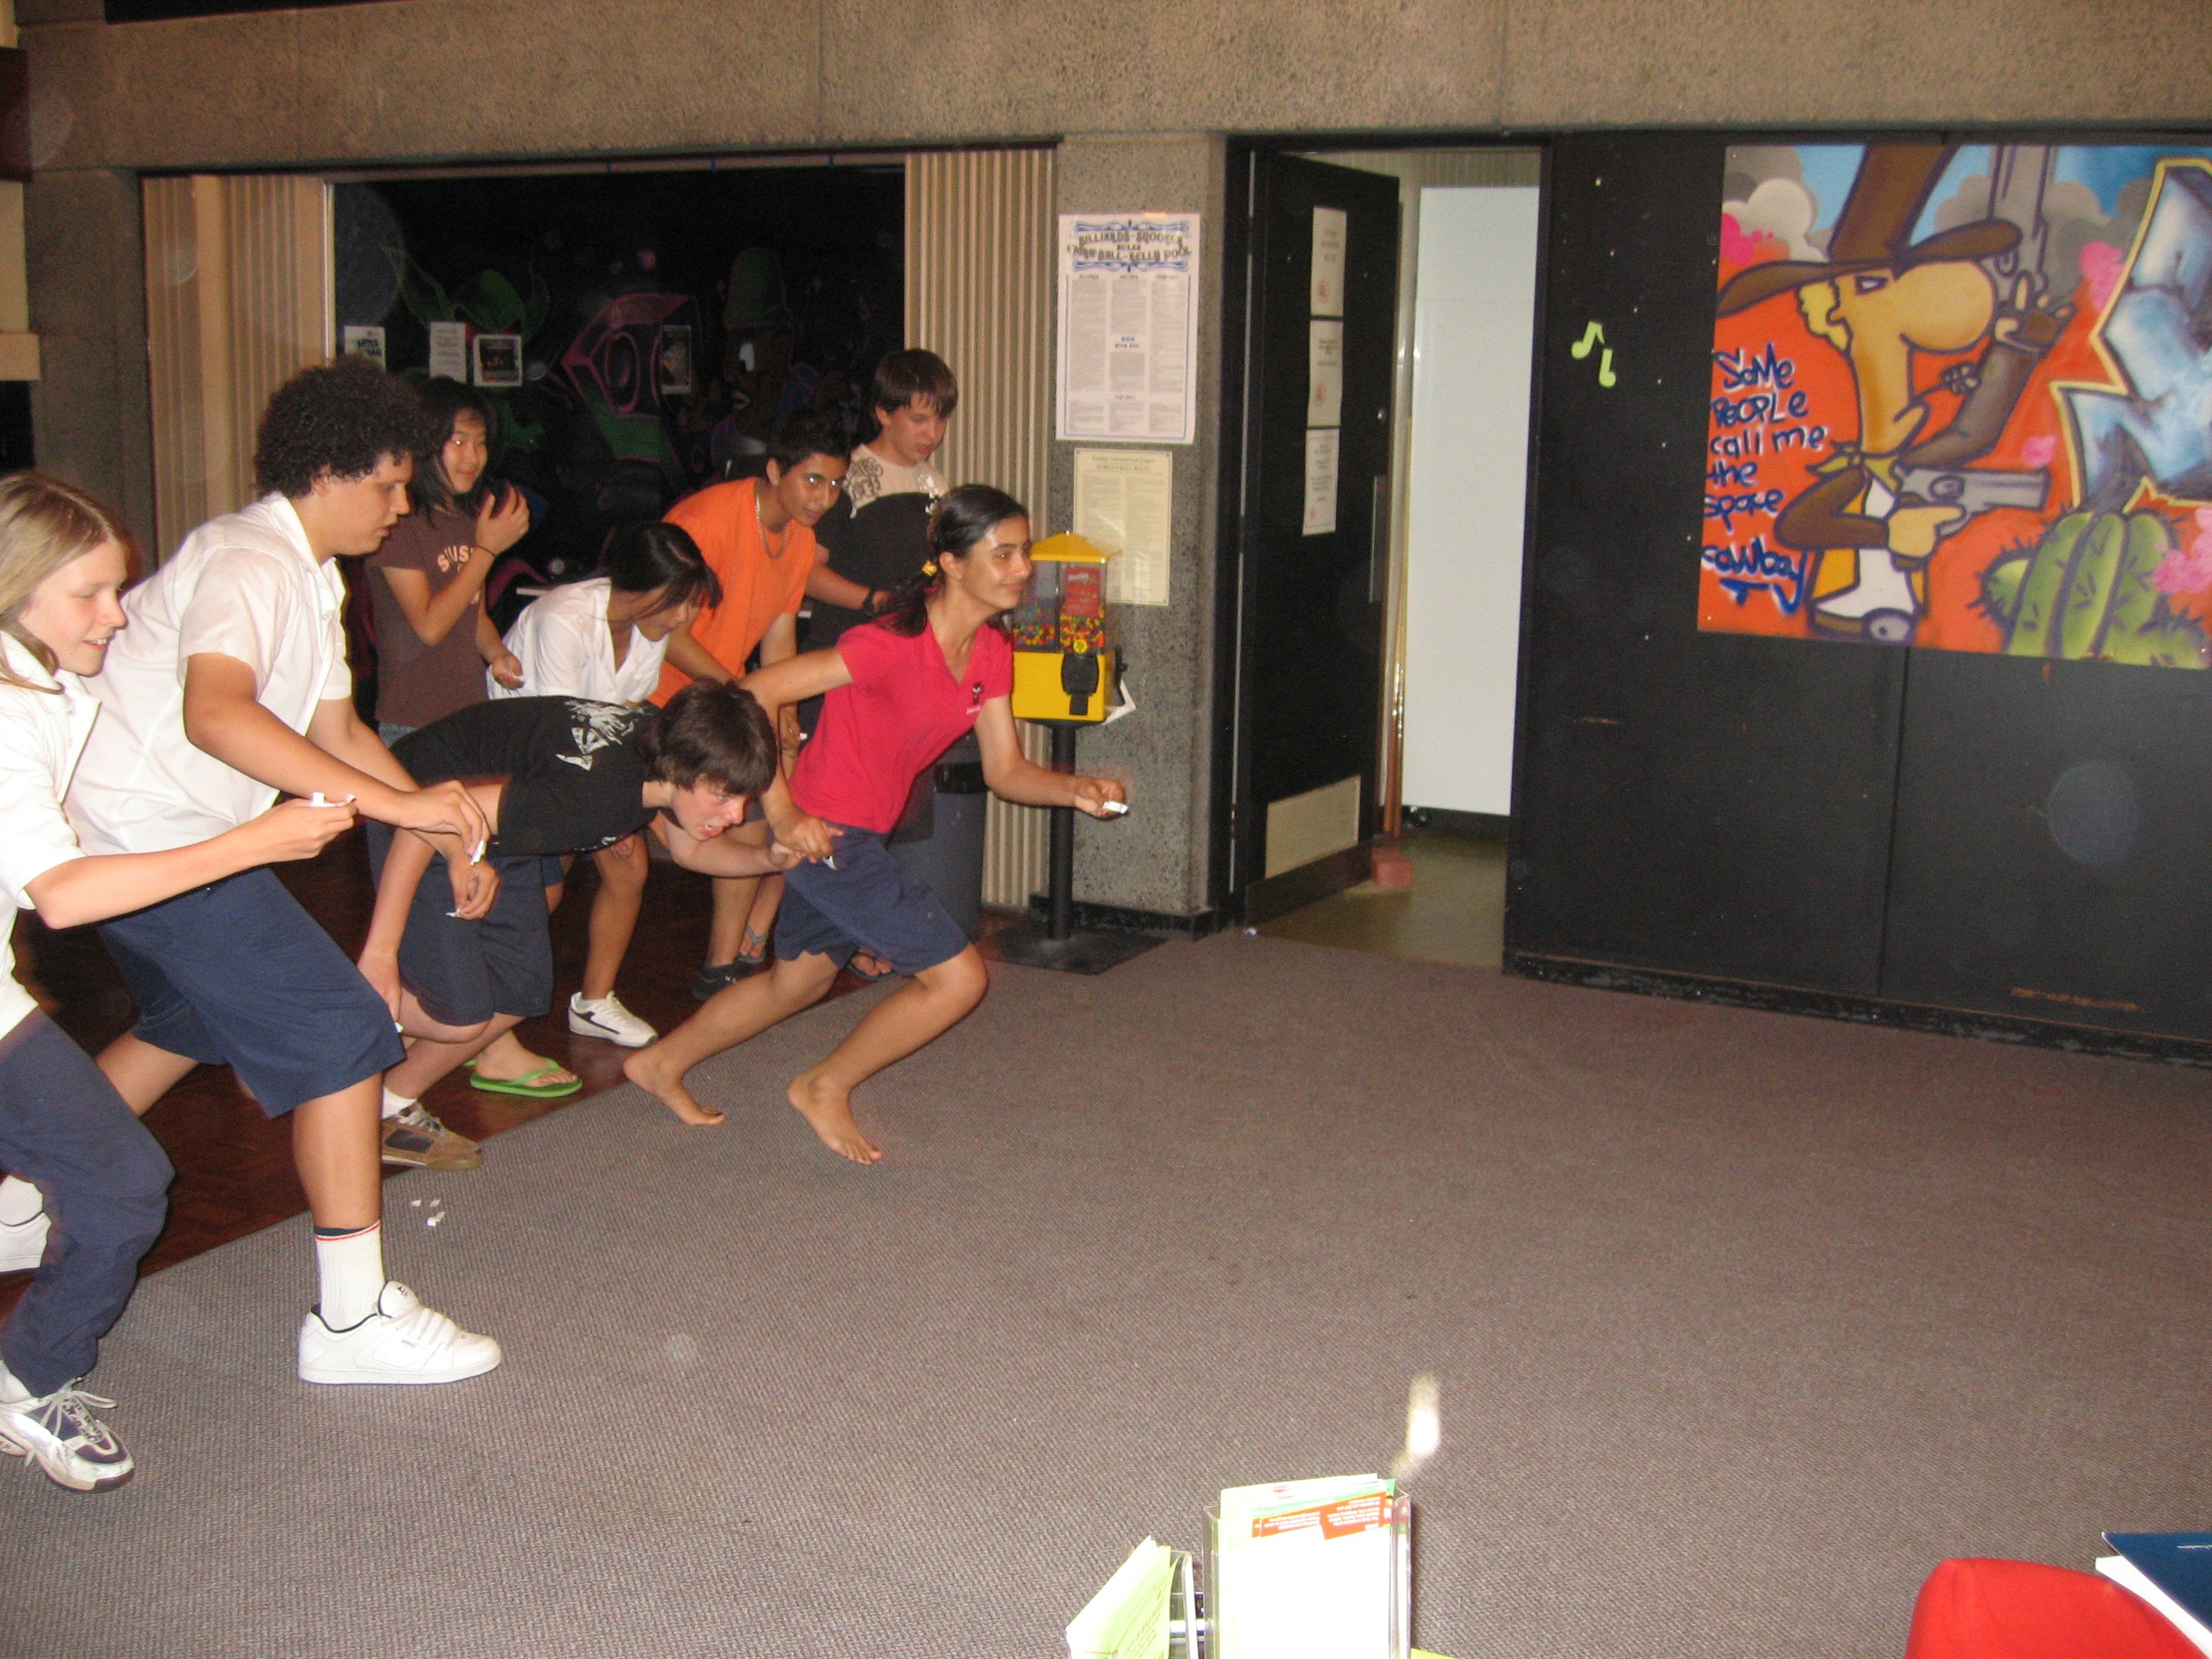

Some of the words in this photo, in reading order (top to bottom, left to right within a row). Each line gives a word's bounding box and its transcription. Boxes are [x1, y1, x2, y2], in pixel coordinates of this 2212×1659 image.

[1098, 249, 1121, 261] BALL
[1164, 246, 1192, 261] POOL
[1709, 428, 1763, 457] call
[1771, 425, 1829, 454] me
[1707, 459, 1758, 487] the
